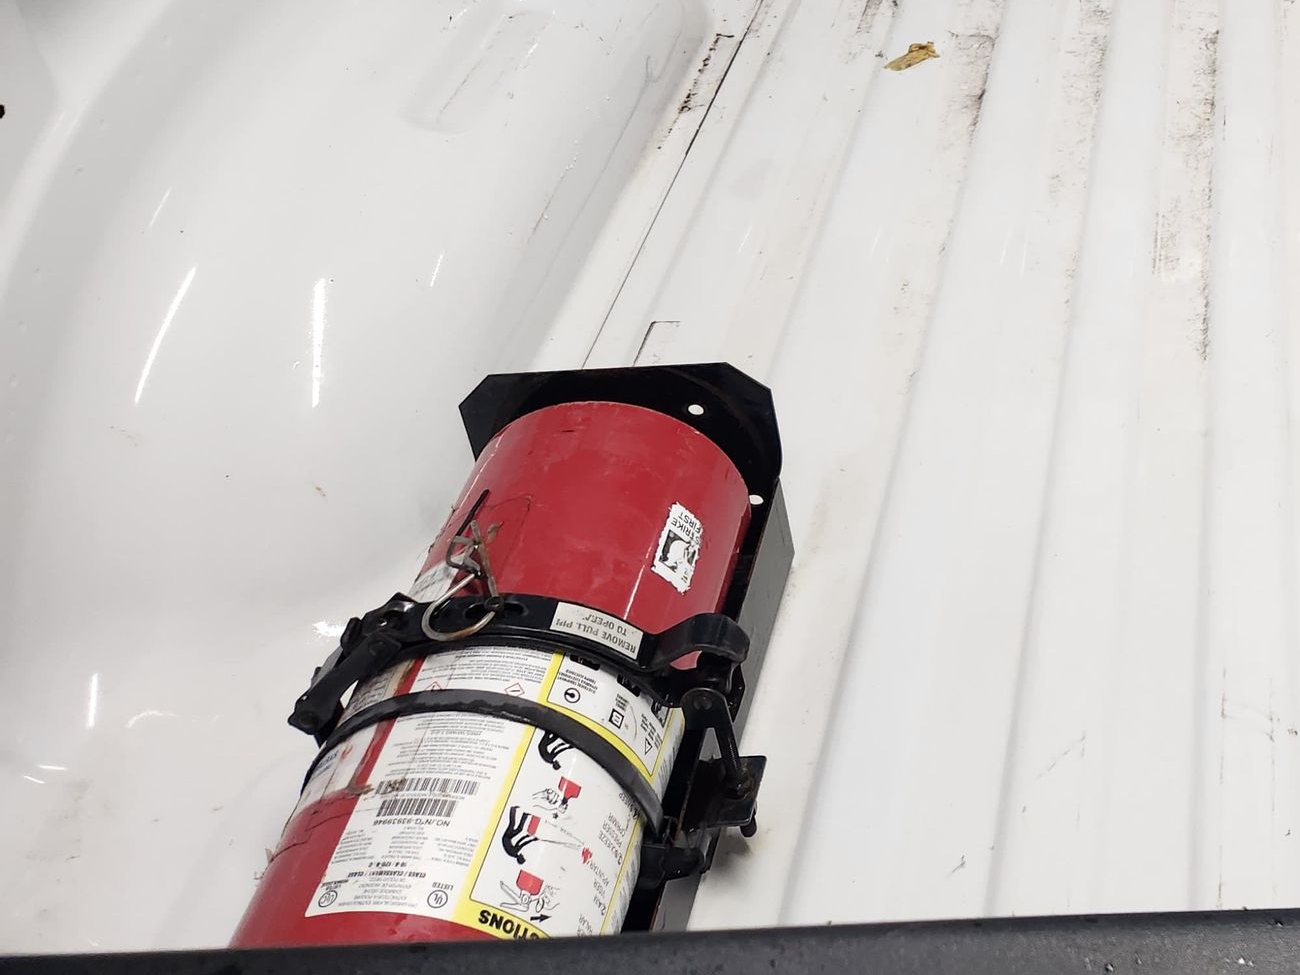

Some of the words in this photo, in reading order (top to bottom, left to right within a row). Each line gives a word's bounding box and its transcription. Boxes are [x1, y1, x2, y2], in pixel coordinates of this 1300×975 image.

[678, 512, 701, 534] FIRST
[671, 517, 700, 545] STRIKE
[555, 618, 574, 628] PIN
[576, 622, 599, 637] PULL
[617, 625, 627, 637] TO
[602, 630, 637, 655] REMOVE
[431, 881, 454, 891] LISTED
